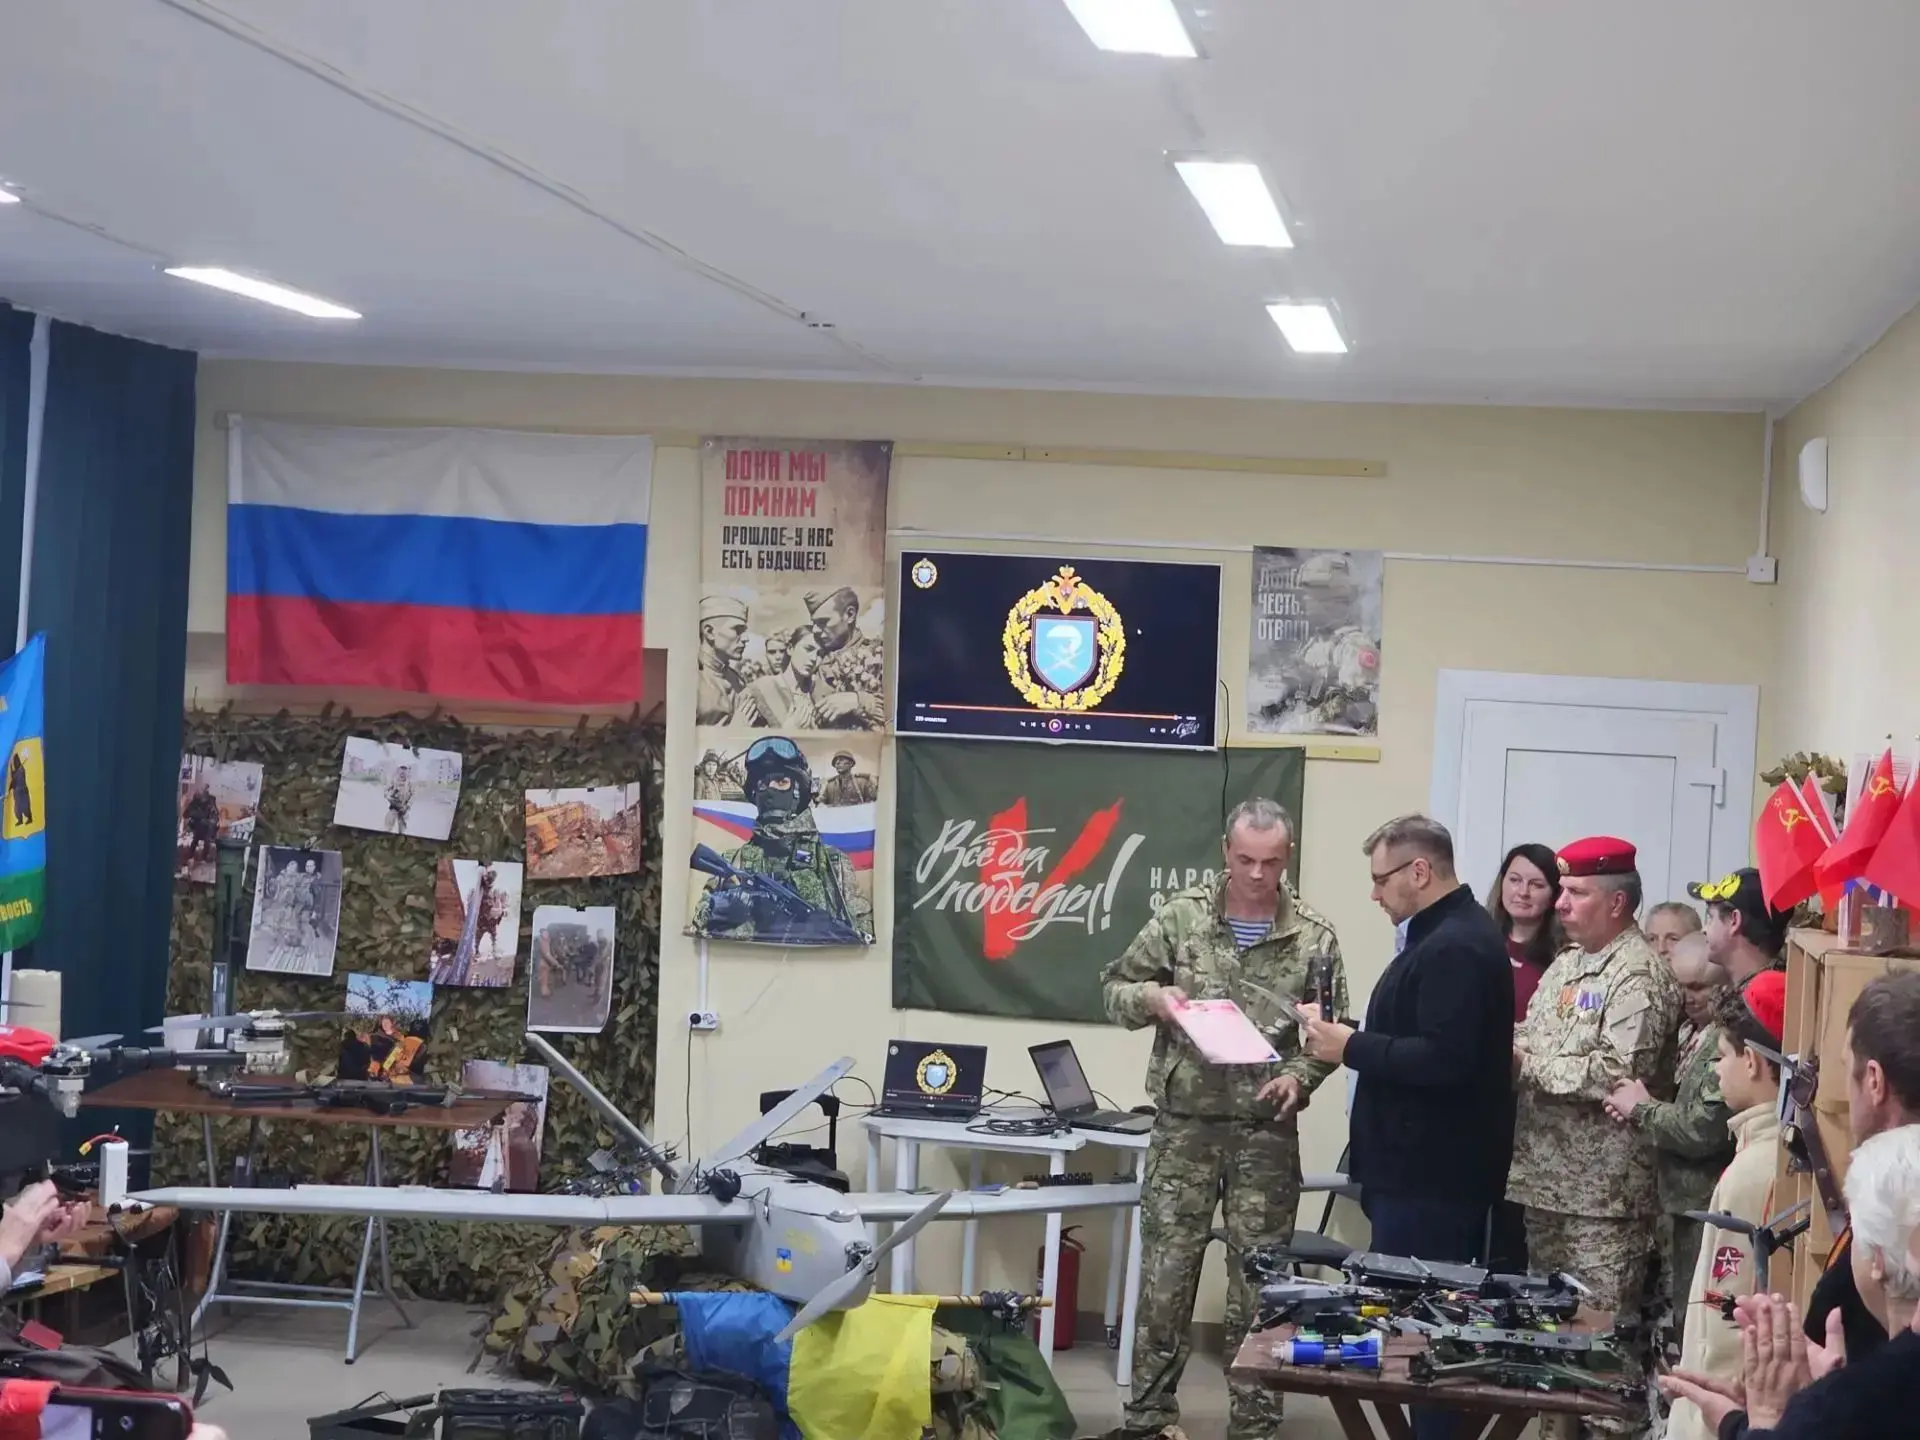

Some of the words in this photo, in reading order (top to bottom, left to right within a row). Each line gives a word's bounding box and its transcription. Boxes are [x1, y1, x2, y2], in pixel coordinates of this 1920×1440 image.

[725, 449, 780, 481] ПОКА
[788, 450, 827, 482] МЫ
[723, 485, 817, 517] ПОМНИМ
[807, 527, 834, 547] НАС
[721, 549, 752, 569] ЕСТЬ
[757, 550, 827, 572] БУДУЩЕЕ!
[934, 833, 1146, 941] победы!
